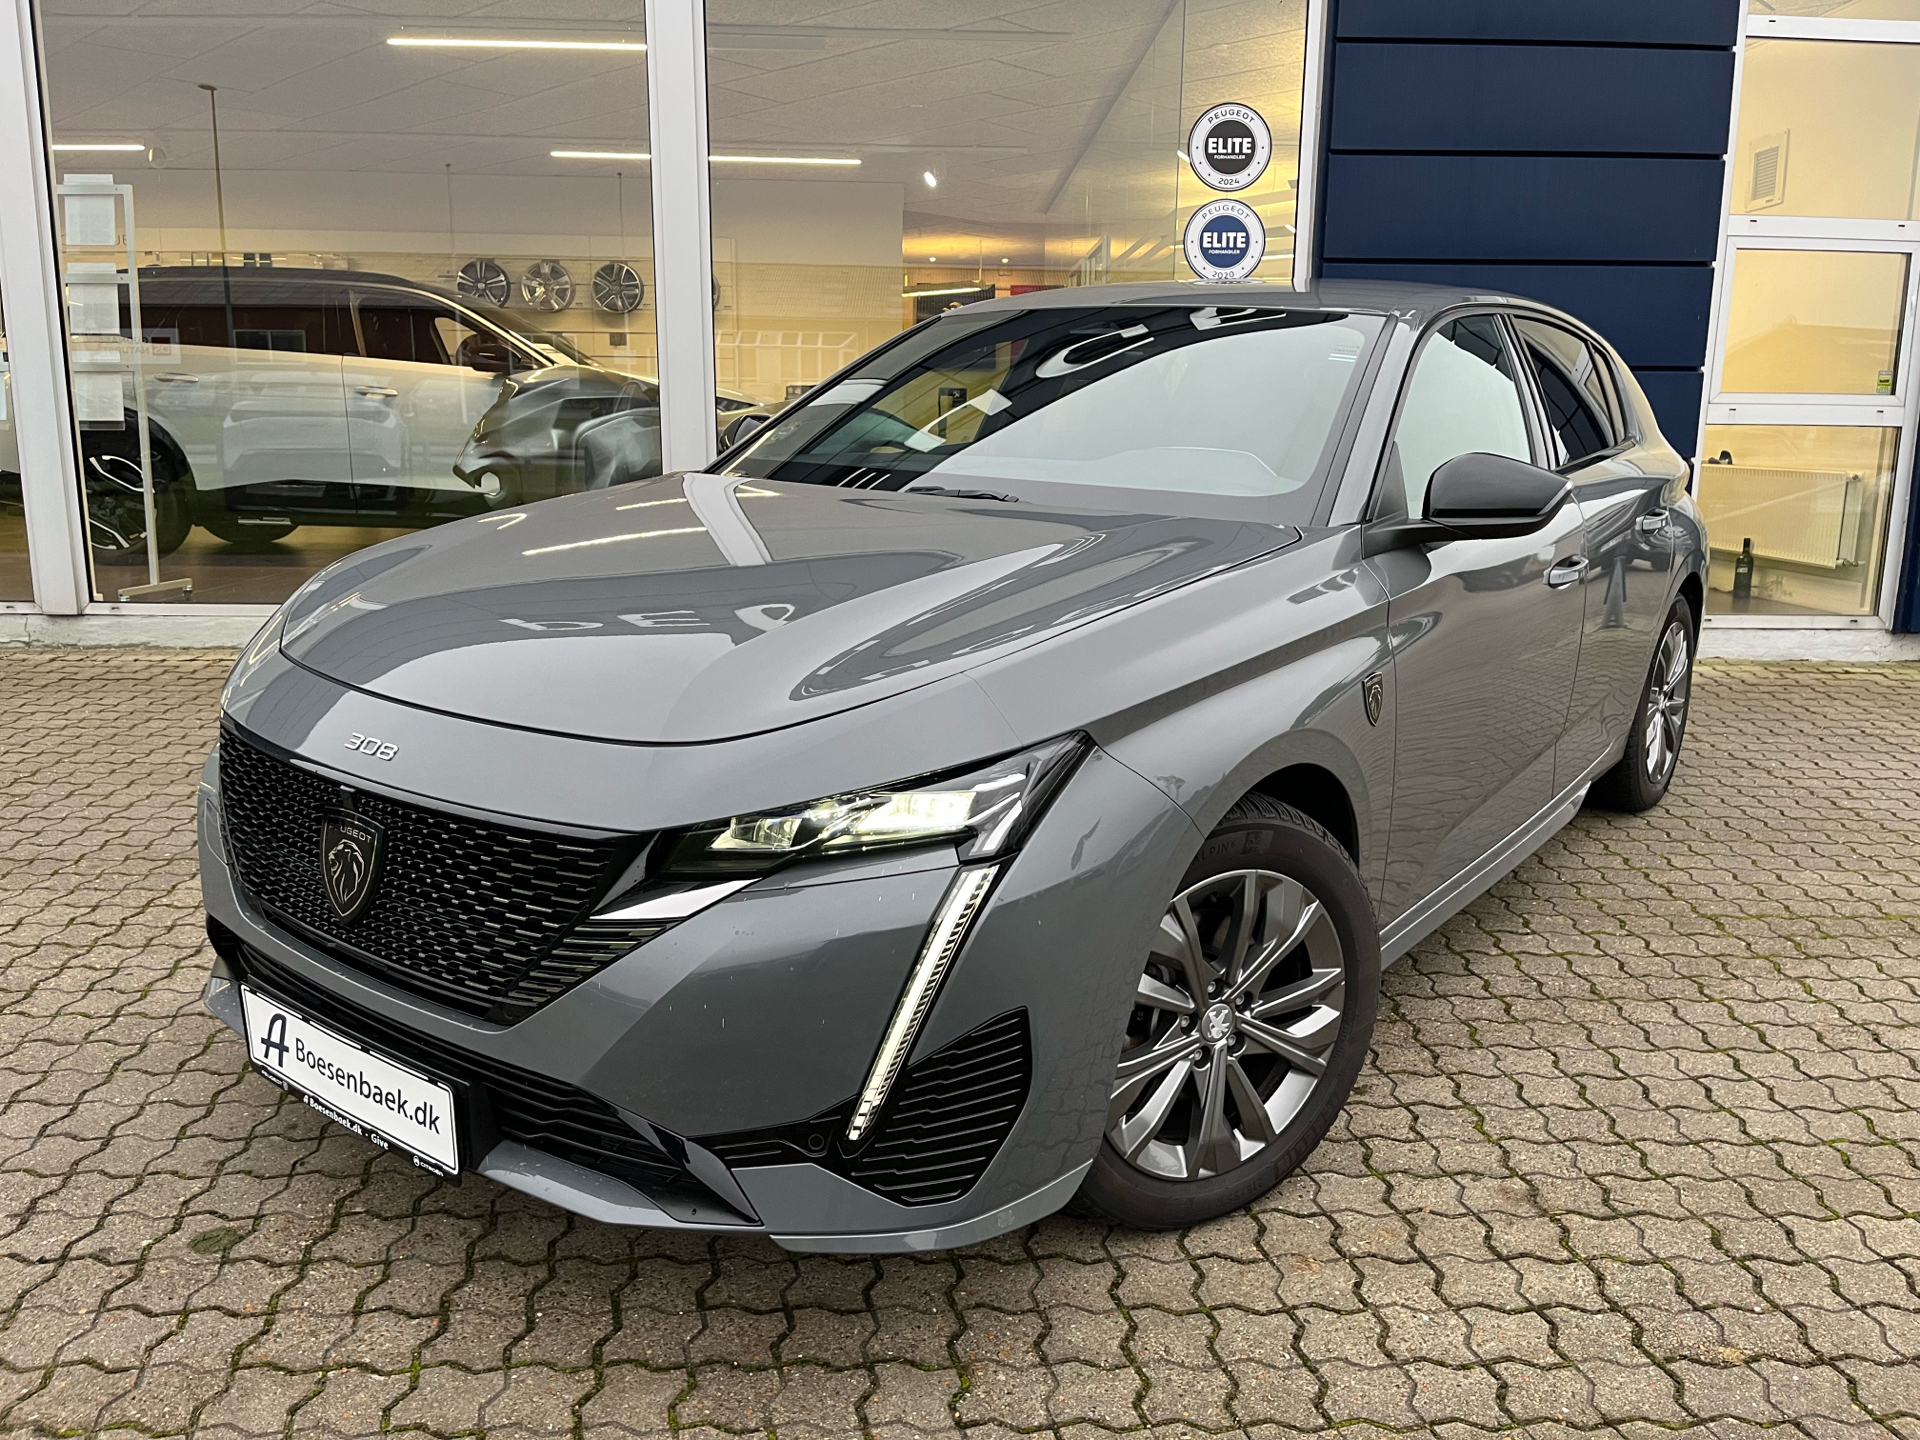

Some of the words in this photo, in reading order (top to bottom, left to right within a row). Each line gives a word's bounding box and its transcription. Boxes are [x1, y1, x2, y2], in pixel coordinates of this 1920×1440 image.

[1207, 108, 1256, 125] PEUGEOT
[1207, 137, 1253, 154] ELITE
[1218, 177, 1241, 186] 2024
[1201, 204, 1251, 220] PEUGEOT
[1202, 231, 1247, 248] ELITE
[1212, 270, 1235, 280] 2020
[343, 731, 399, 761] 308
[328, 822, 372, 844] PEUGEOT
[261, 1013, 290, 1068] A
[295, 1037, 441, 1135] Boesenbaek.dk
[309, 1097, 363, 1136] Boesenbaek.dk
[370, 1133, 389, 1150] Give
